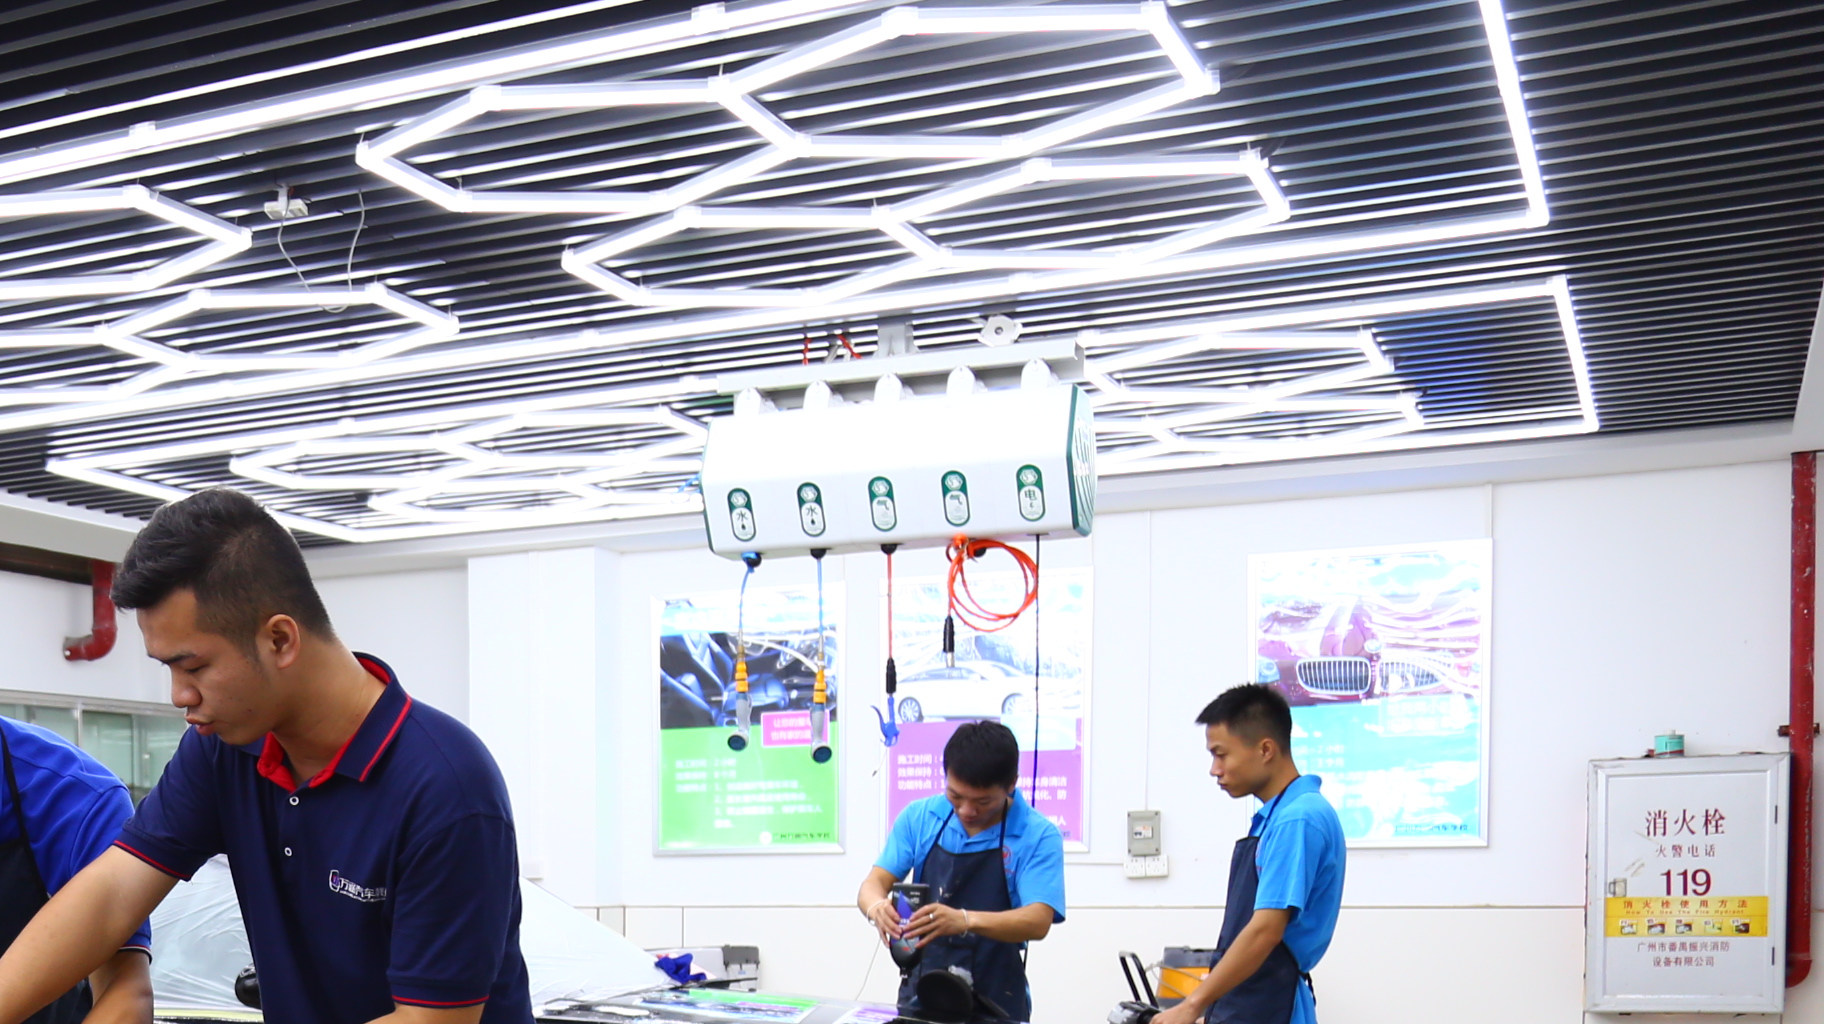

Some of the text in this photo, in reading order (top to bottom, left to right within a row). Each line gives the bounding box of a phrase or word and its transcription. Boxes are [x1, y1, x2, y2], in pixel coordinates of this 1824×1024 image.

[1024, 488, 1037, 501] 电
[737, 511, 749, 522] 水
[806, 505, 818, 517] 水
[1645, 808, 1726, 837] 消火栓
[1655, 843, 1716, 858] 火警电话
[1660, 868, 1712, 897] 119
[1623, 900, 1748, 909] 消火栓使用方法
[1637, 941, 1730, 953] 广州市番禺振兴消防
[1653, 956, 1714, 967] 设备有限公司
